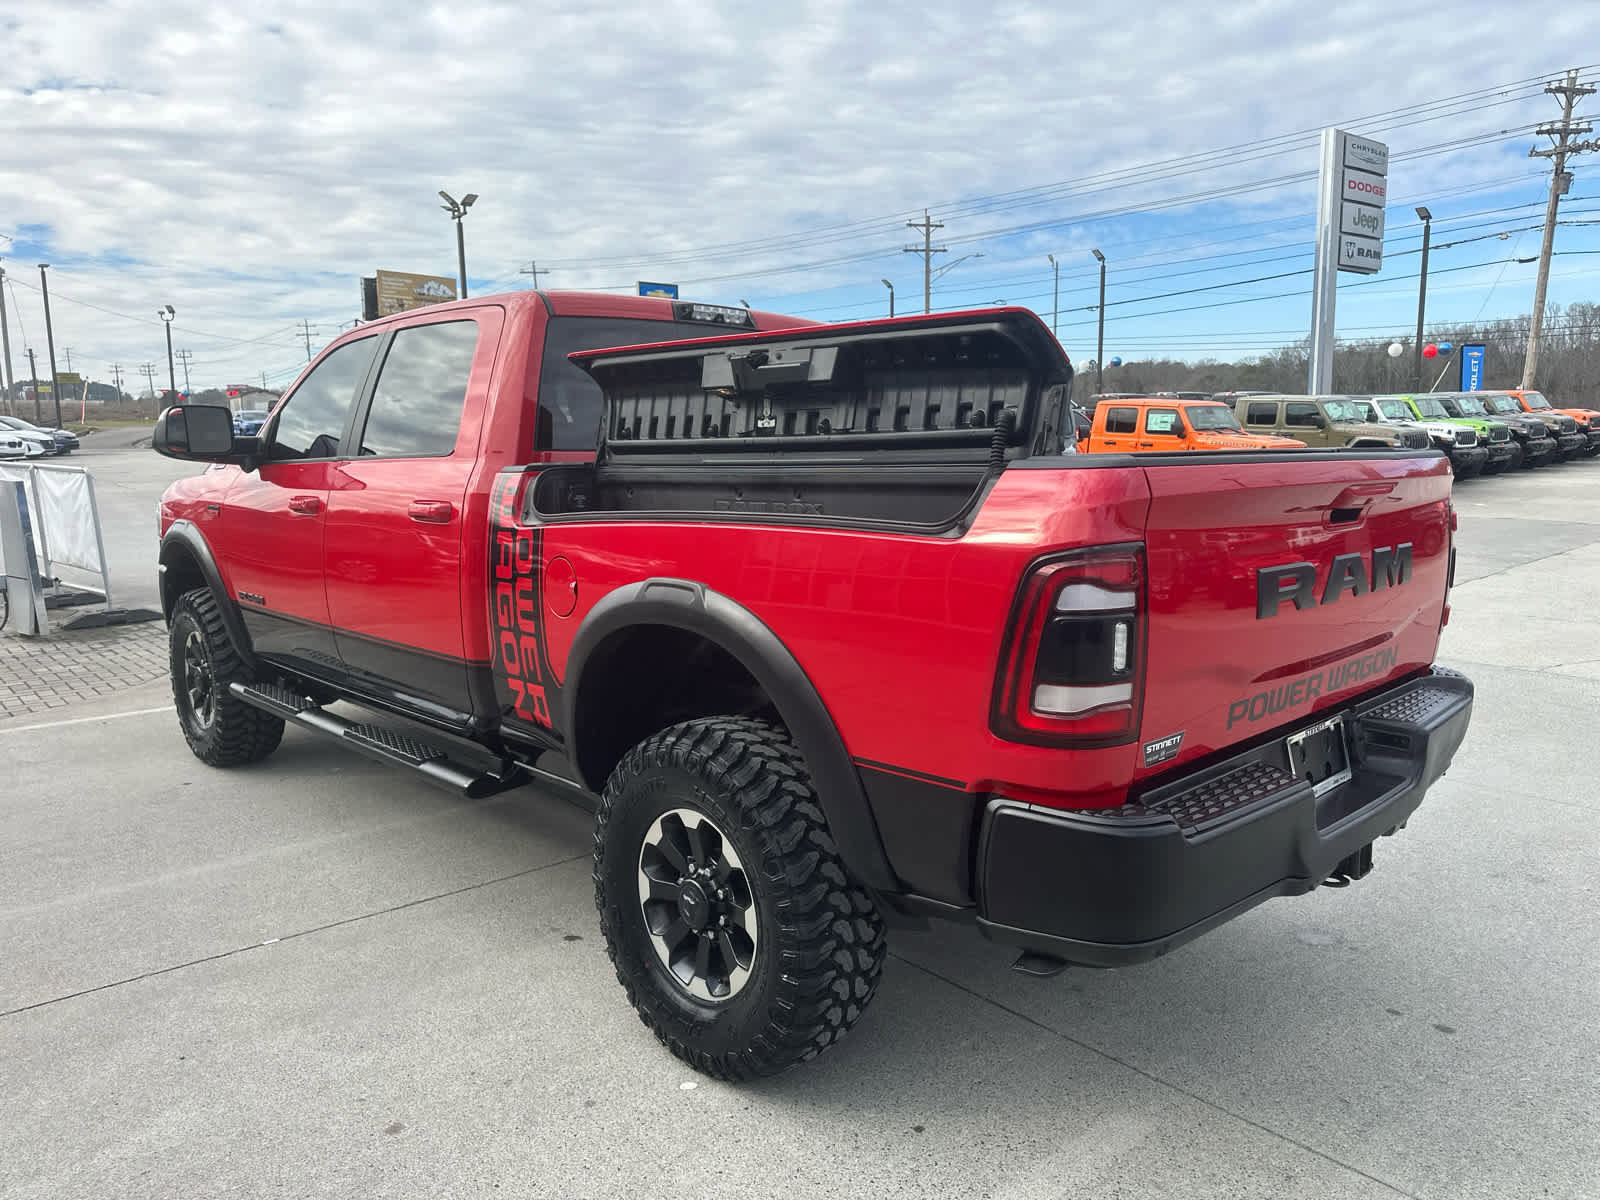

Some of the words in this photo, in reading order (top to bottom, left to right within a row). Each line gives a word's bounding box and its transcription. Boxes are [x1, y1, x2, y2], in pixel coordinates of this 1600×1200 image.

[1351, 143, 1386, 158] CHRYSLER
[1348, 179, 1385, 196] DODGE
[1353, 208, 1379, 233] Jeep
[1357, 247, 1381, 260] RAM
[1256, 542, 1413, 619] RAM
[515, 529, 553, 728] OWER
[1226, 672, 1323, 730] POWER
[1327, 646, 1399, 692] WAGON
[1146, 735, 1181, 754] STINNETT
